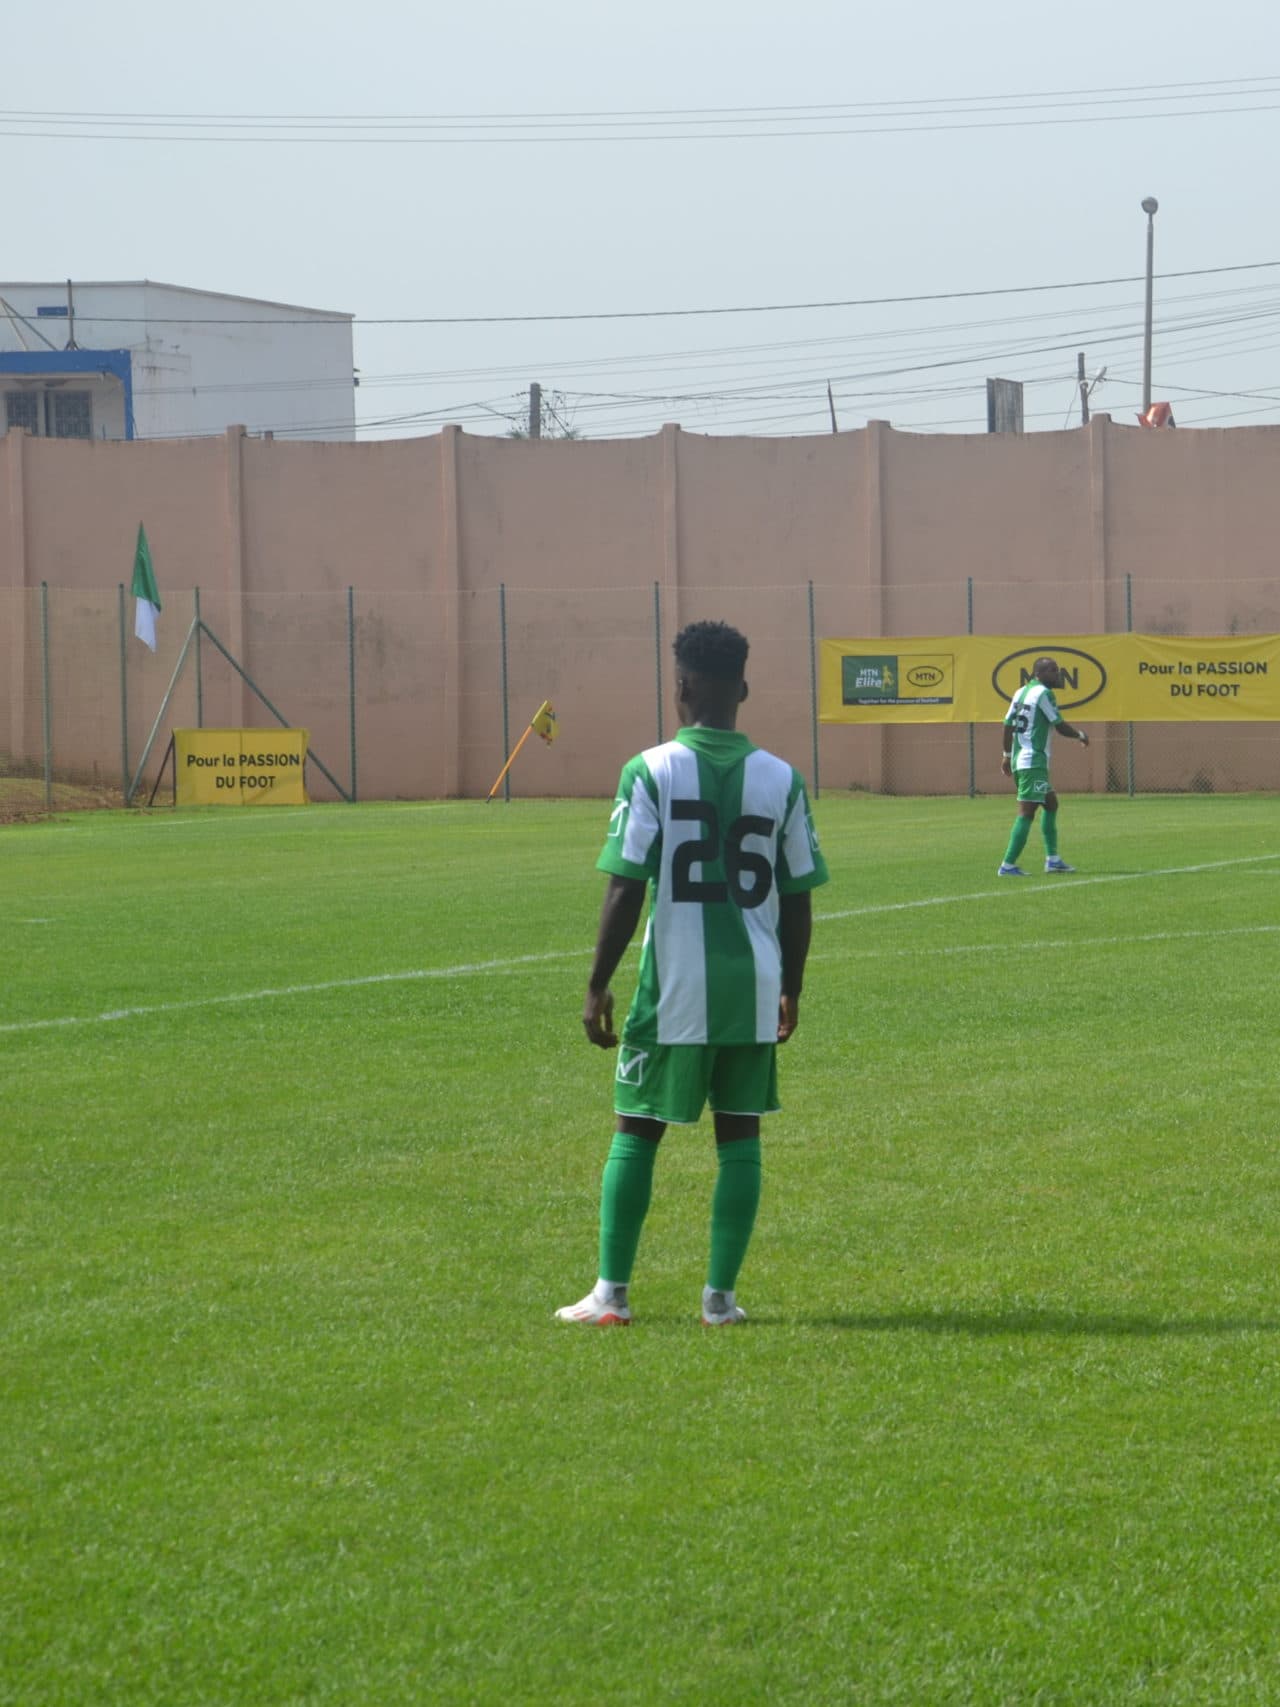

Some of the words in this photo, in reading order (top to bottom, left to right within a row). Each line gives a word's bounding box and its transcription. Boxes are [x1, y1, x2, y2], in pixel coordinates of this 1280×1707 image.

[860, 668, 879, 676] MTN
[1138, 662, 1174, 675] Pour
[1178, 662, 1192, 675] la
[1197, 662, 1267, 675] PASSION
[855, 677, 882, 688] Elite
[915, 672, 936, 681] MTN
[1020, 667, 1078, 689] MN
[1171, 684, 1193, 697] DU
[1197, 684, 1240, 697] FOOT
[187, 754, 219, 767] Pour
[223, 754, 236, 767] la
[239, 754, 300, 767] PASSION
[216, 776, 236, 789] DU
[239, 776, 276, 789] FOOT
[671, 799, 775, 909] 26
